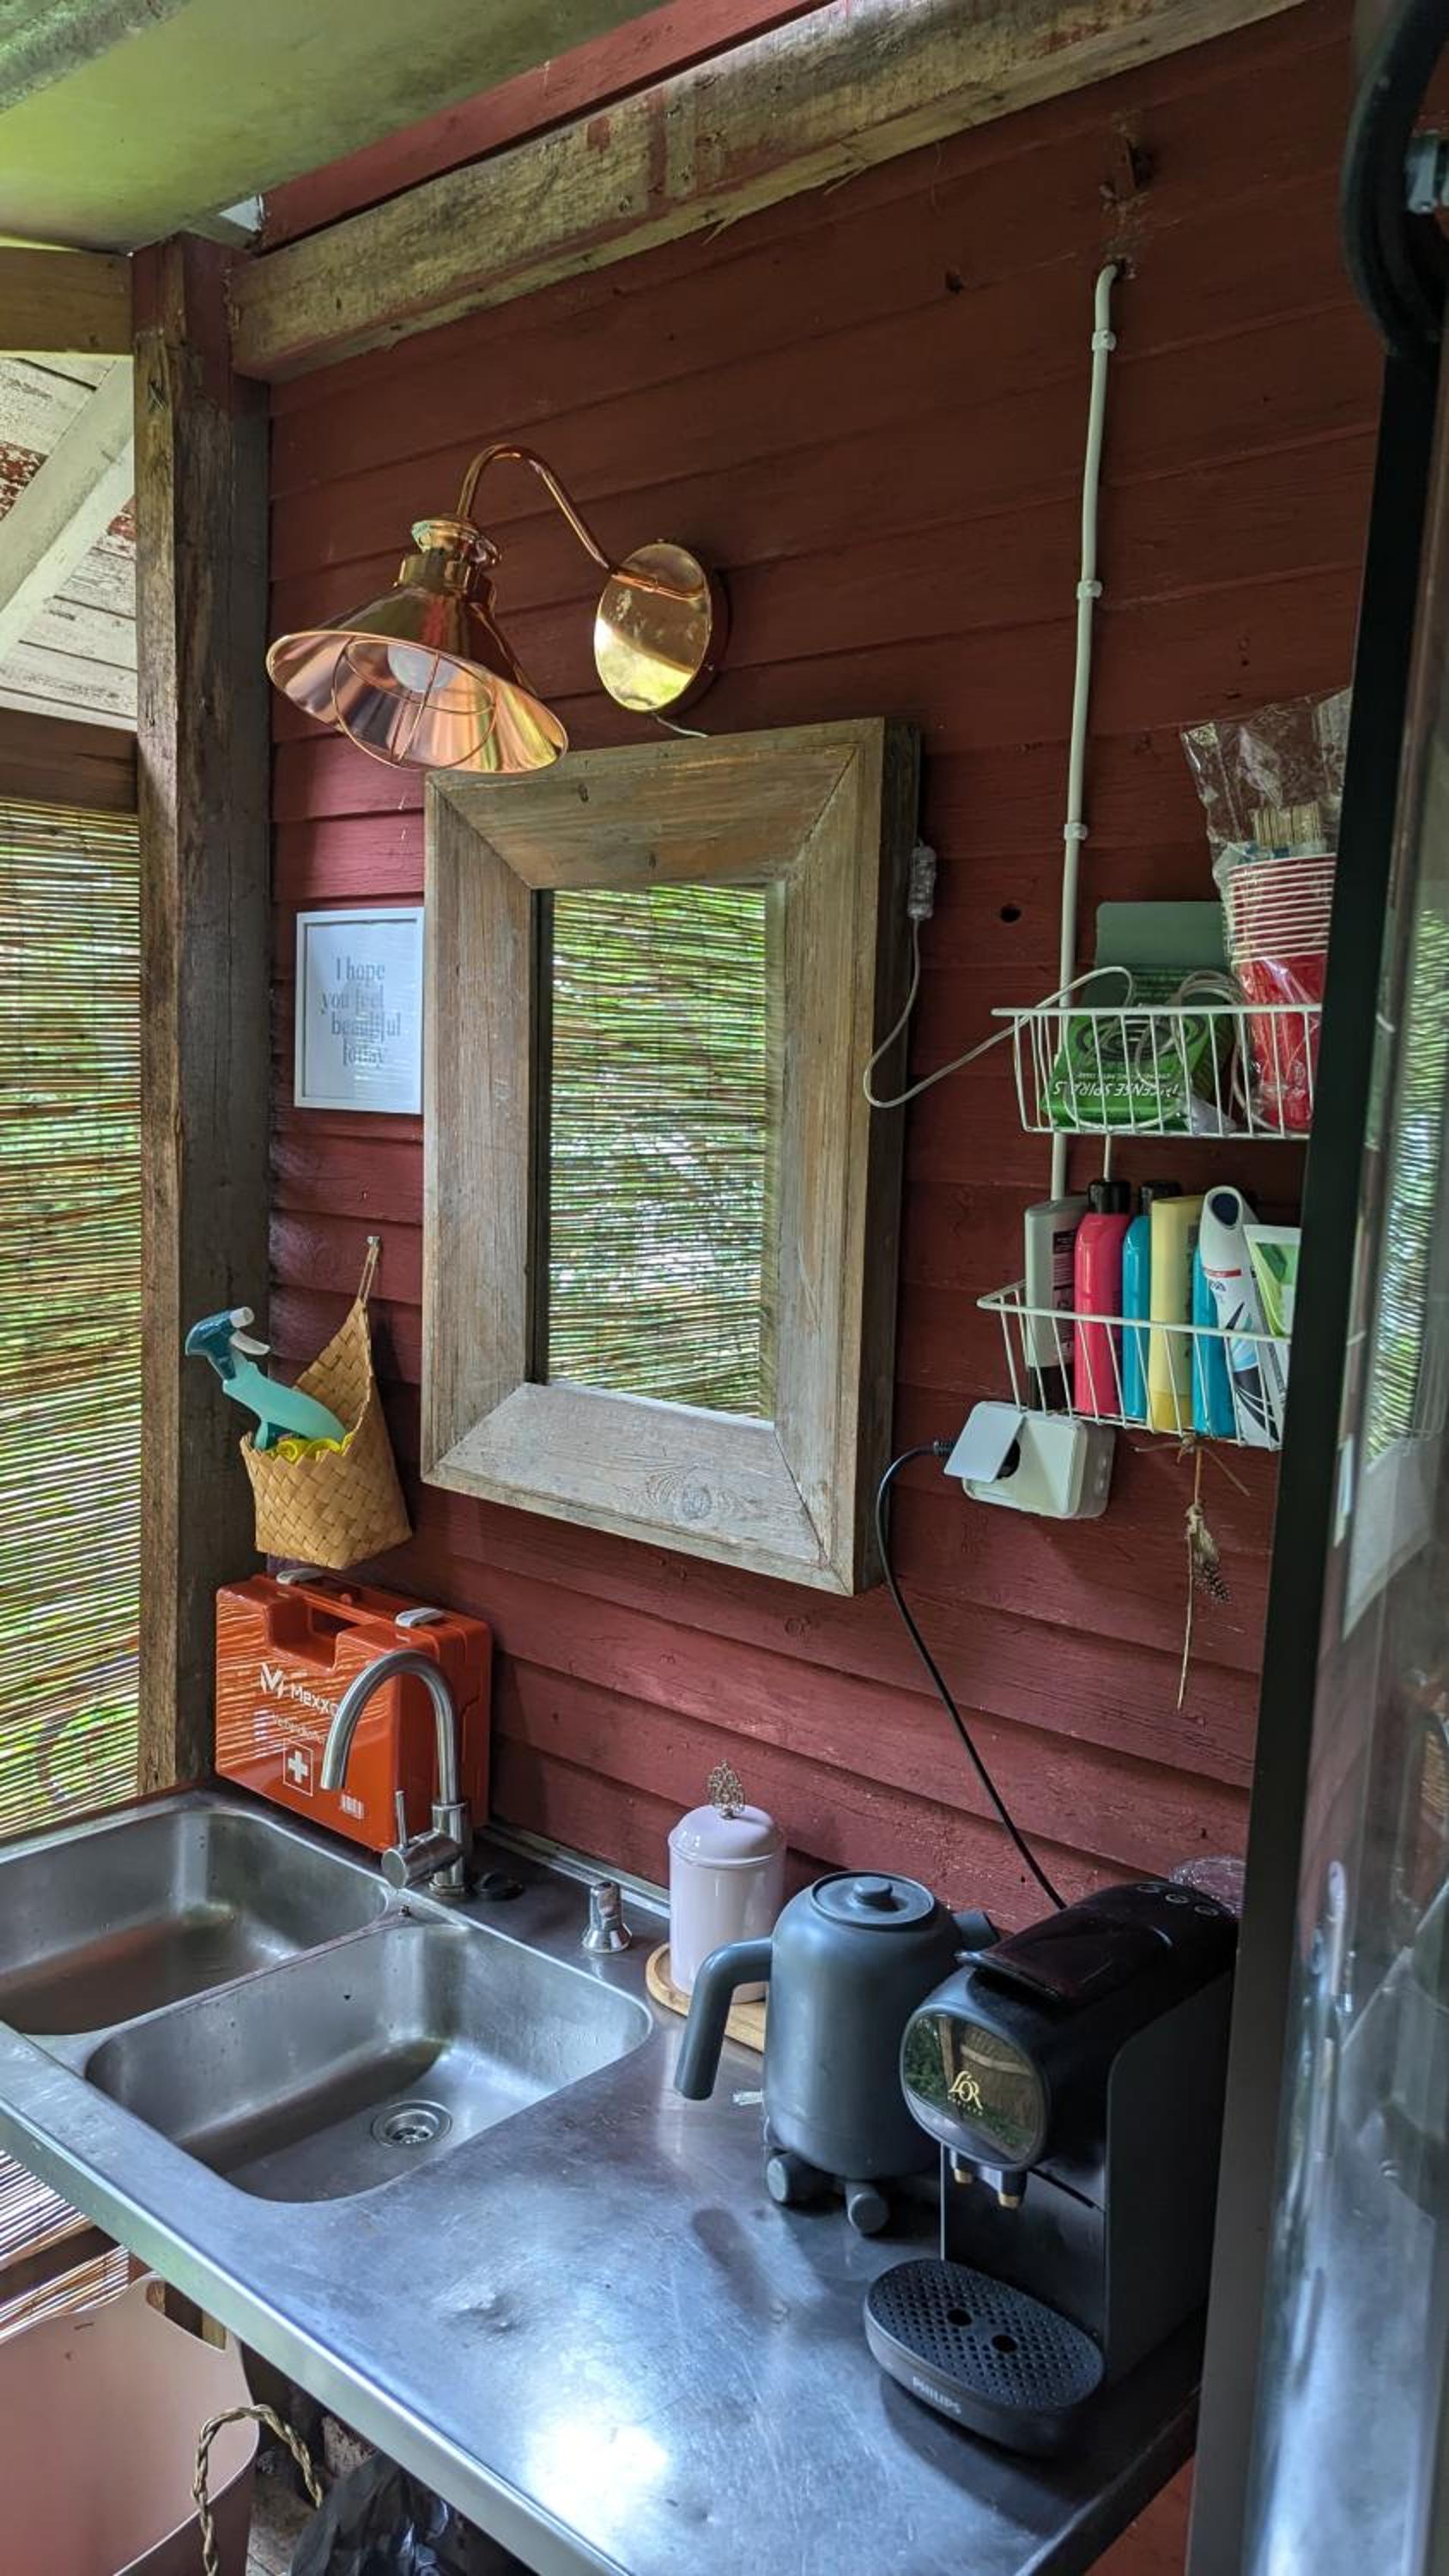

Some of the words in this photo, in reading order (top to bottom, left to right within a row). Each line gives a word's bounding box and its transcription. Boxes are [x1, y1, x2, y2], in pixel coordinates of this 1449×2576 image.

[346, 956, 385, 988] hope
[319, 992, 349, 1015] you
[355, 984, 385, 1014] feel
[330, 1012, 401, 1044] beautiful
[912, 2375, 961, 2415] PHILIPS
